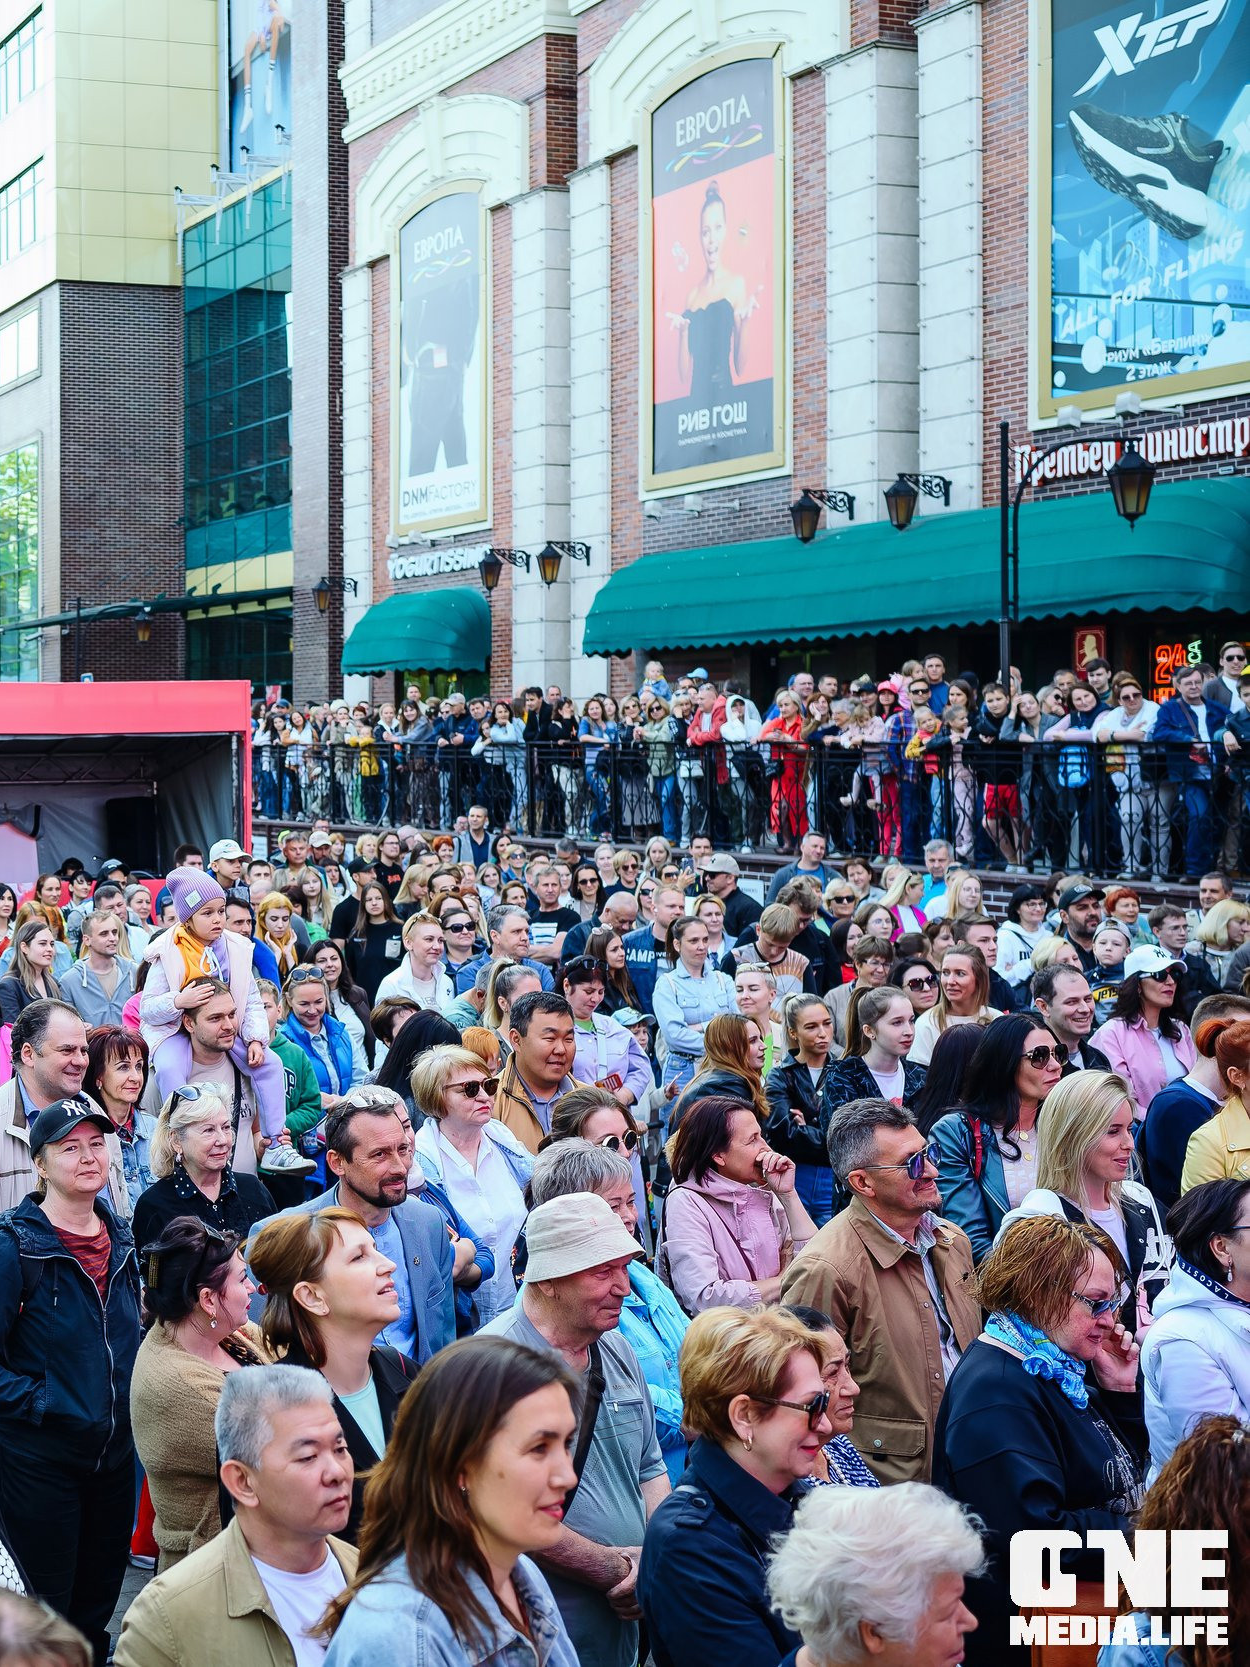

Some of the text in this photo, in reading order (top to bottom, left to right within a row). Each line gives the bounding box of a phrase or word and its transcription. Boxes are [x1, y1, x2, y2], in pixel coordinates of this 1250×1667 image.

[1072, 0, 1228, 98] XTEP
[675, 94, 751, 147] ЕВРОПА
[413, 224, 465, 264] ЕВРОПА
[1060, 229, 1245, 340] ALL FOR FLYING
[1126, 364, 1136, 382] 2
[678, 401, 748, 435] РИВ ГОШ
[1181, 1262, 1229, 1300] LACOSTE
